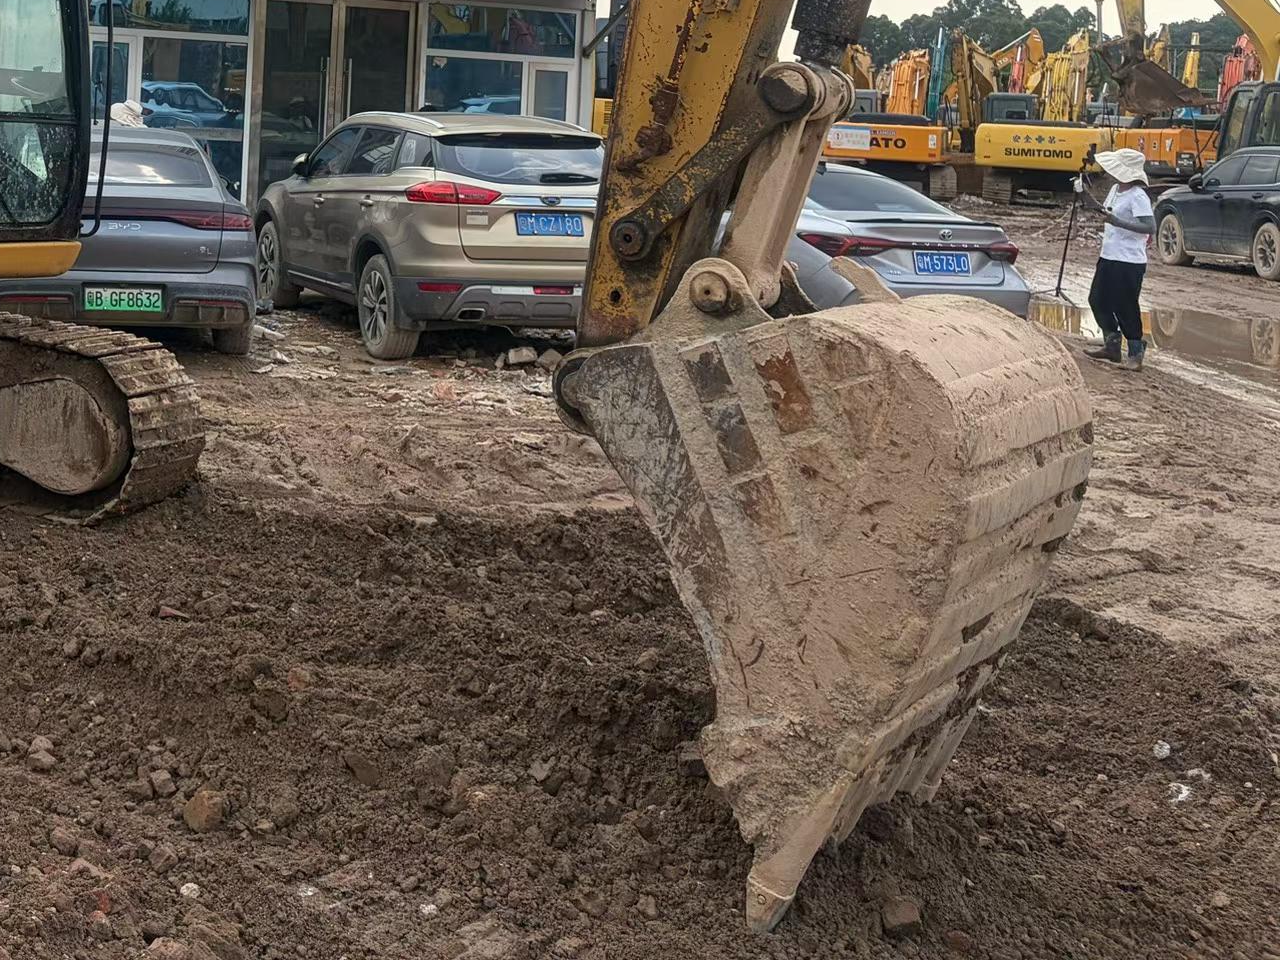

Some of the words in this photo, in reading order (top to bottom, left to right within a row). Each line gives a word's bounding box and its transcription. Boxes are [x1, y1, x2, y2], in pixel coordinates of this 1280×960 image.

[869, 136, 907, 149] ATO
[1004, 147, 1073, 159] SUMITOMO
[107, 222, 143, 231] BYD
